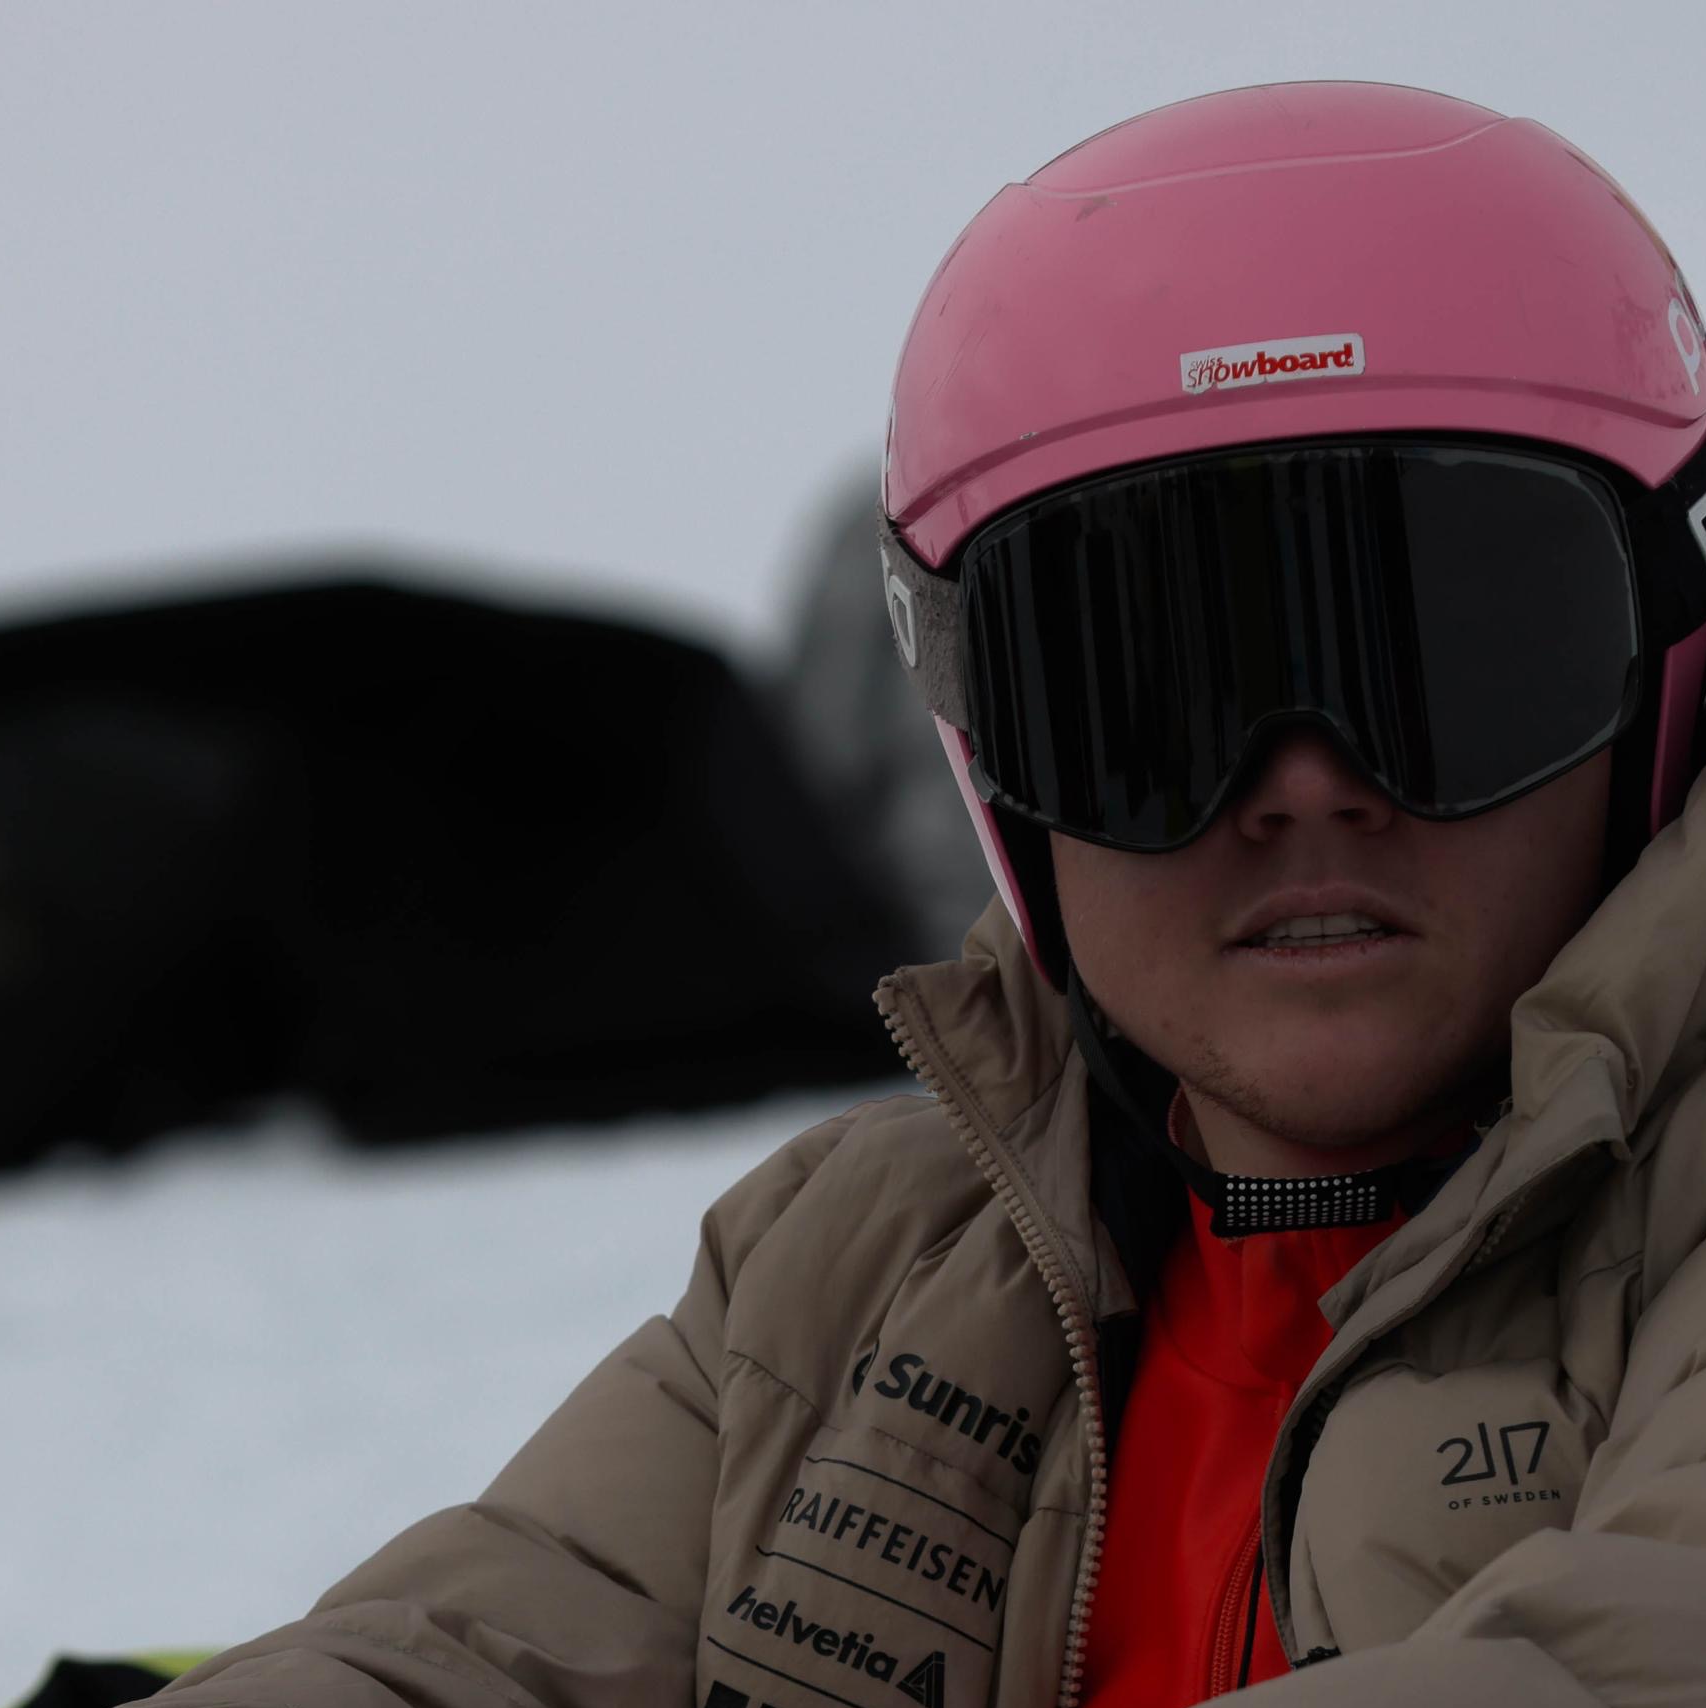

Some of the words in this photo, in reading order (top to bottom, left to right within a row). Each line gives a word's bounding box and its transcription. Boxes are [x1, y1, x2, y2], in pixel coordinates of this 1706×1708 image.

[1186, 342, 1355, 388] snowboard
[1448, 1498, 1472, 1510] OF
[1482, 1489, 1561, 1506] SWEDEN
[780, 1488, 1006, 1612] RAIFFEISEN
[727, 1586, 899, 1683] helvetia
